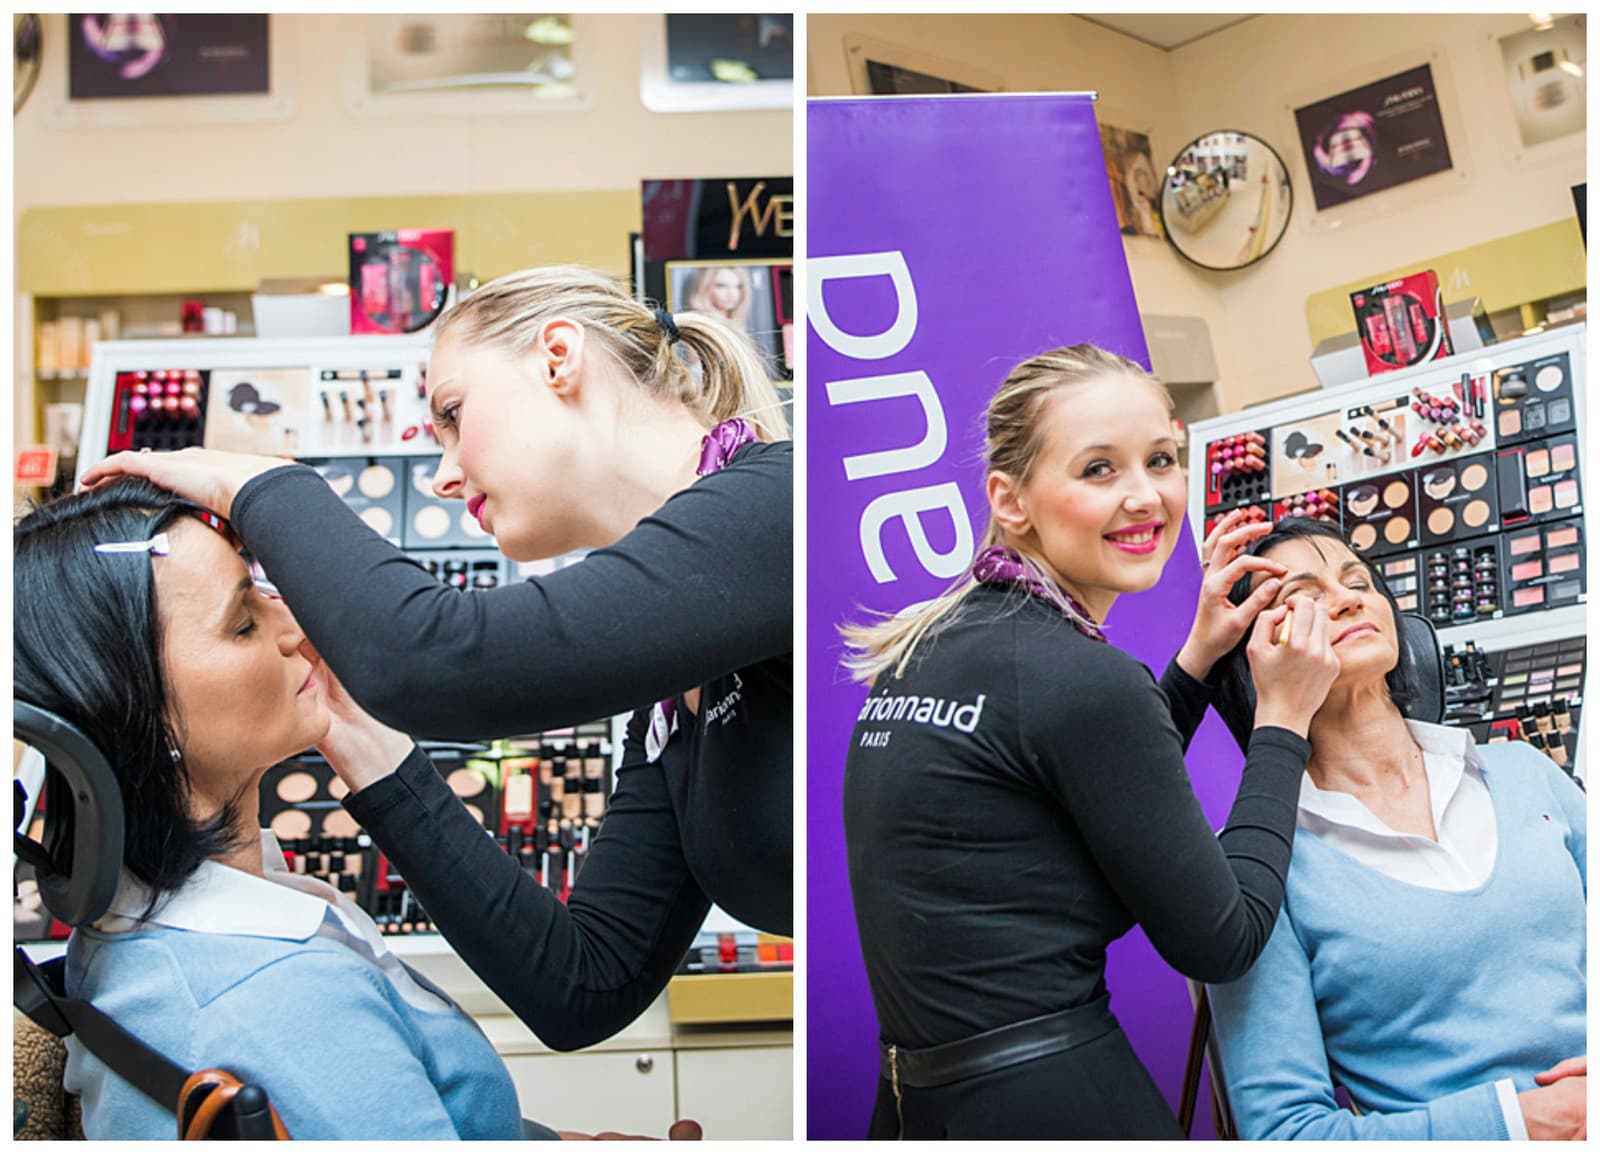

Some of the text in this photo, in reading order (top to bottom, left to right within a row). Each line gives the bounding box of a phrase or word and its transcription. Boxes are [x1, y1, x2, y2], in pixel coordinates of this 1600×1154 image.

[727, 181, 793, 250] YVE
[807, 250, 974, 618] aud
[860, 731, 892, 747] PARIS
